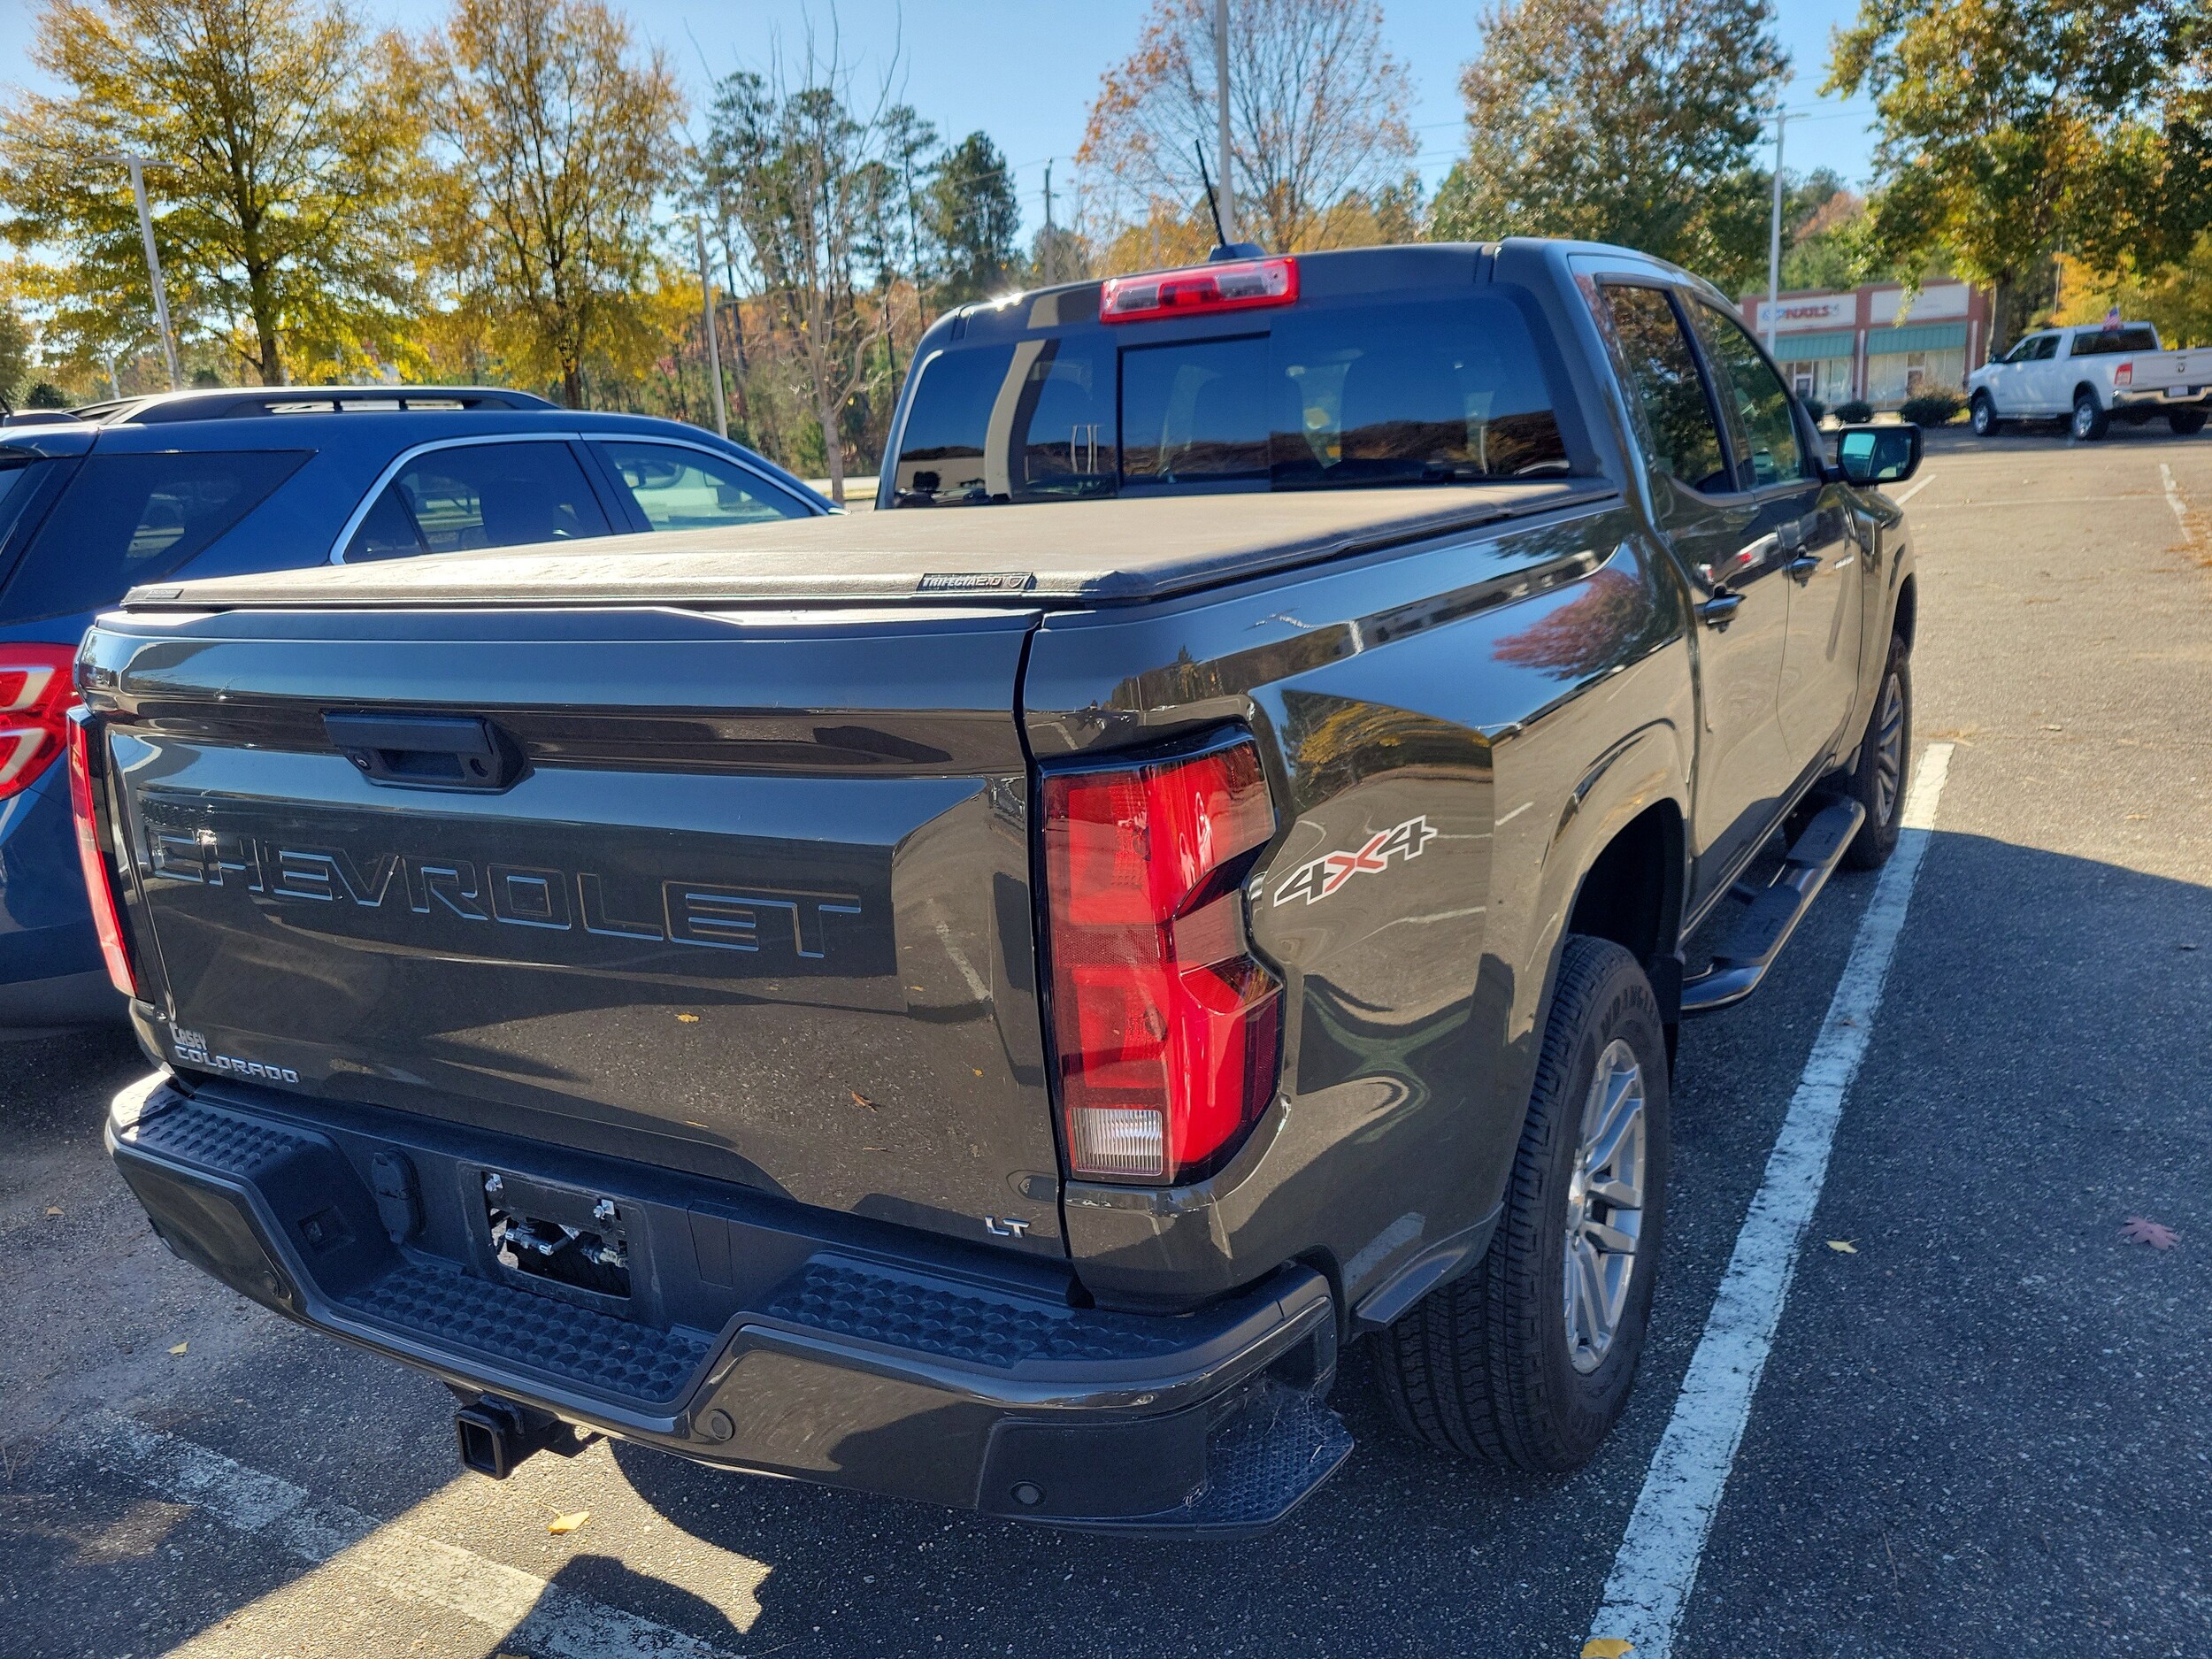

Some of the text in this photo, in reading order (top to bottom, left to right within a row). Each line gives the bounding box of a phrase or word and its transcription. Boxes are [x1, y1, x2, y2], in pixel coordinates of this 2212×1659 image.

[145, 825, 863, 958] CHEVROLET
[174, 1046, 300, 1084] COLORADO
[985, 1216, 1030, 1238] LT
